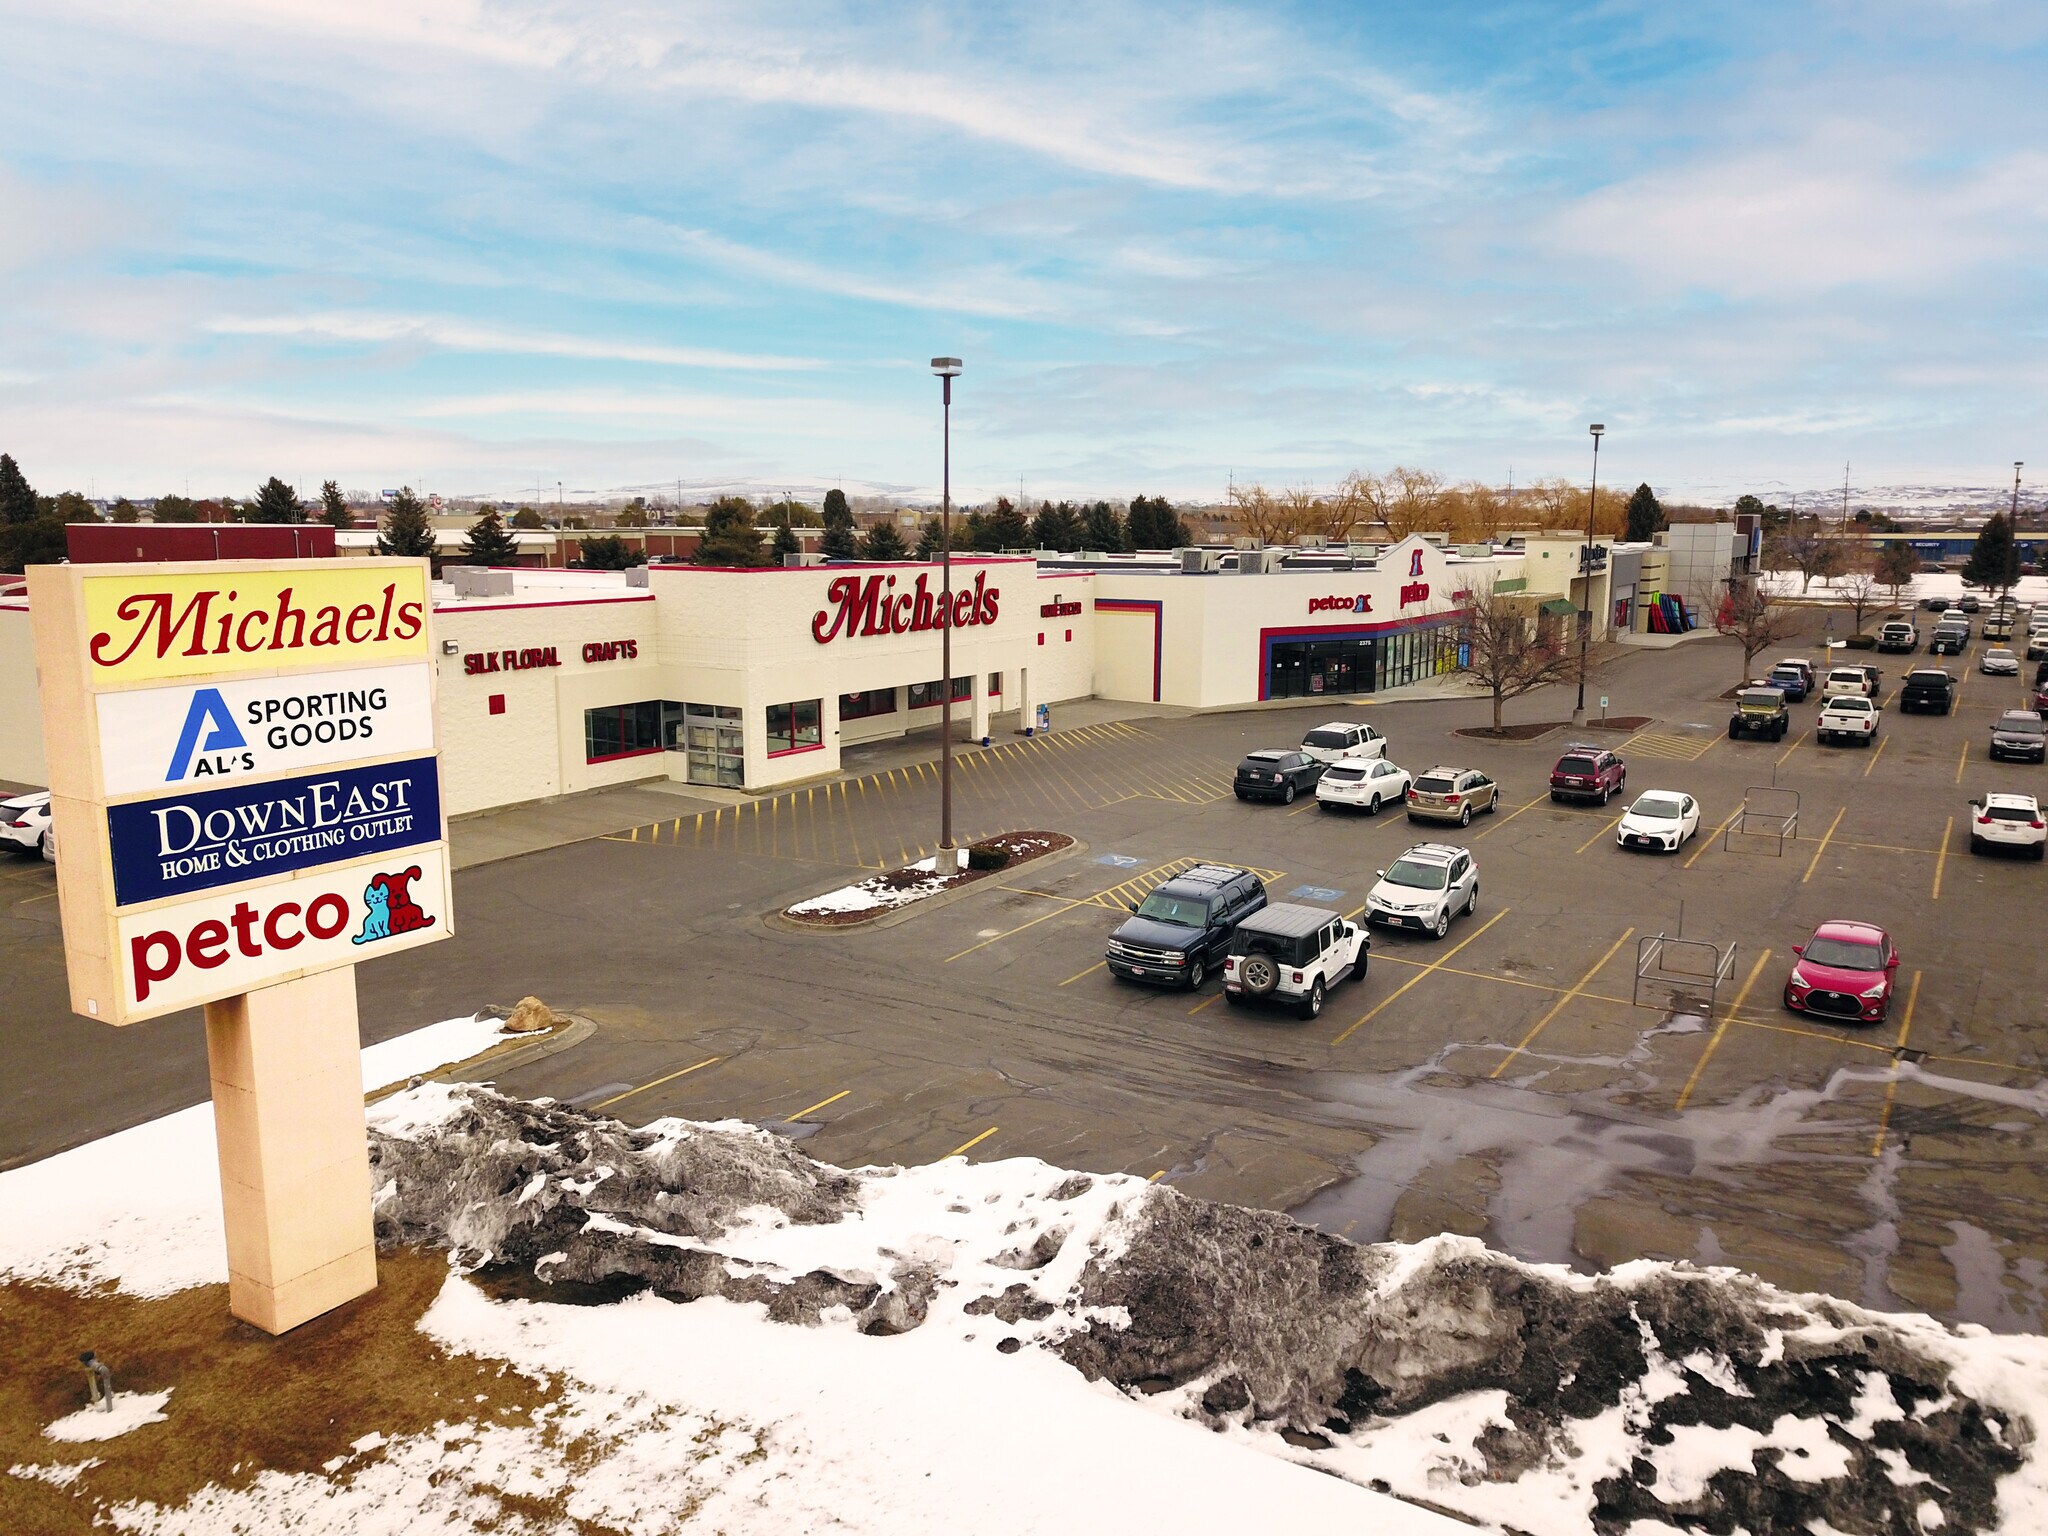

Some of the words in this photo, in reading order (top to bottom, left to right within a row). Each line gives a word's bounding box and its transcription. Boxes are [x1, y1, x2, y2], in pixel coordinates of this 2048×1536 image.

[812, 570, 1000, 644] Michaels
[1309, 595, 1354, 614] petco
[90, 583, 423, 667] Michaels
[464, 652, 501, 675] SILK
[503, 647, 562, 671] FLORAL
[583, 639, 638, 663] CRAFTS
[247, 688, 387, 724] SPORTING
[267, 716, 373, 749] GOODS
[194, 752, 255, 777] AL'S
[161, 852, 221, 880] HOME
[225, 839, 252, 868] &
[253, 829, 345, 861] CLOTHING
[350, 815, 413, 841] OUTLET
[131, 893, 350, 1003] petco
